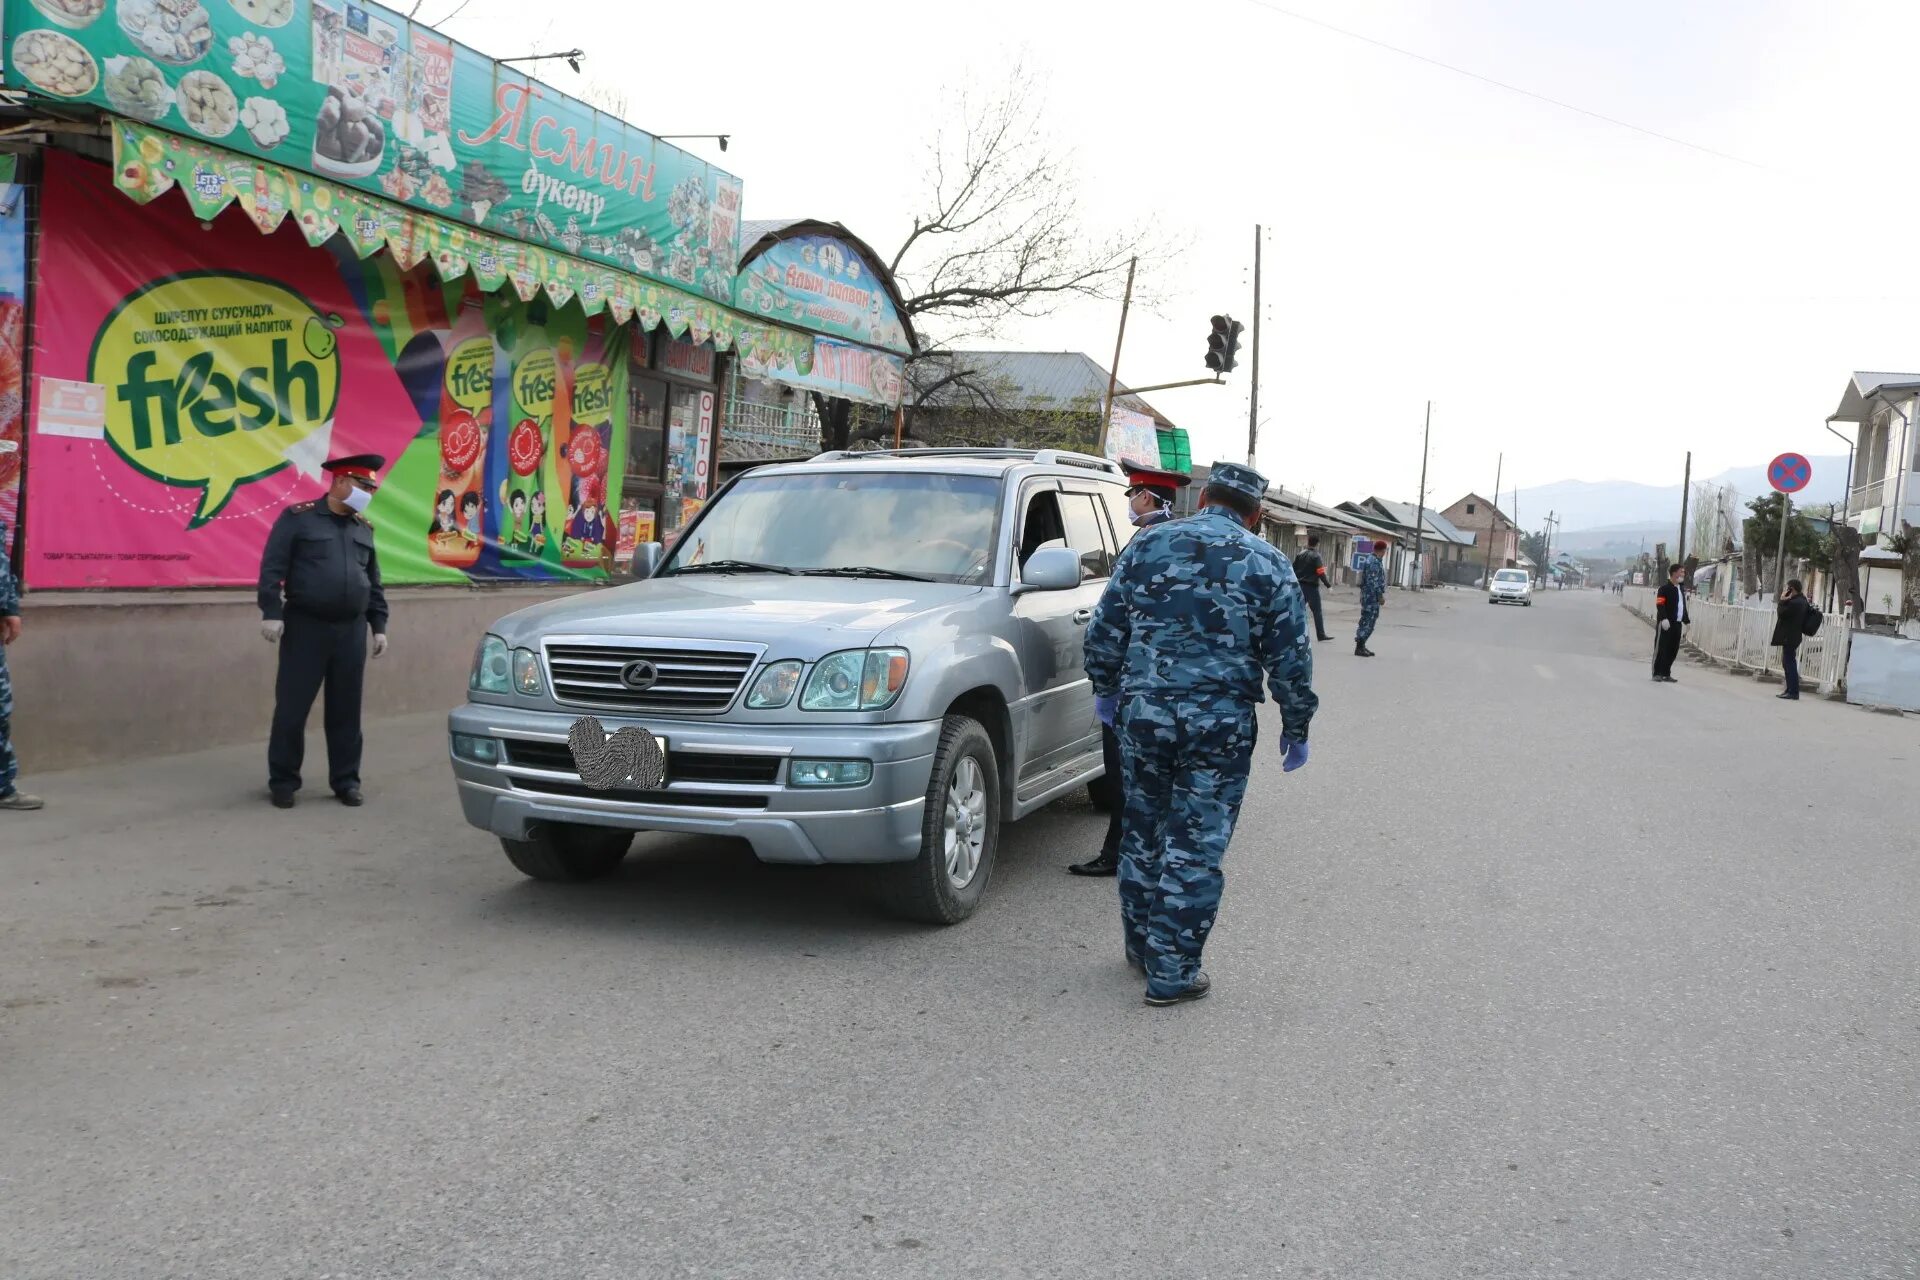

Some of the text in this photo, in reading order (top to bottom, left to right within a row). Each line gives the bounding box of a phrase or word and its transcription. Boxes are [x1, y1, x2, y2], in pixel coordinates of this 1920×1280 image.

[458, 82, 656, 202] Ясмин
[211, 304, 274, 321] СУУСУНДУК
[134, 319, 293, 345] СОКОСОДЕРЖАЩИЙ НАПИТОК
[117, 338, 321, 450] fresh
[1357, 555, 1367, 568] P
